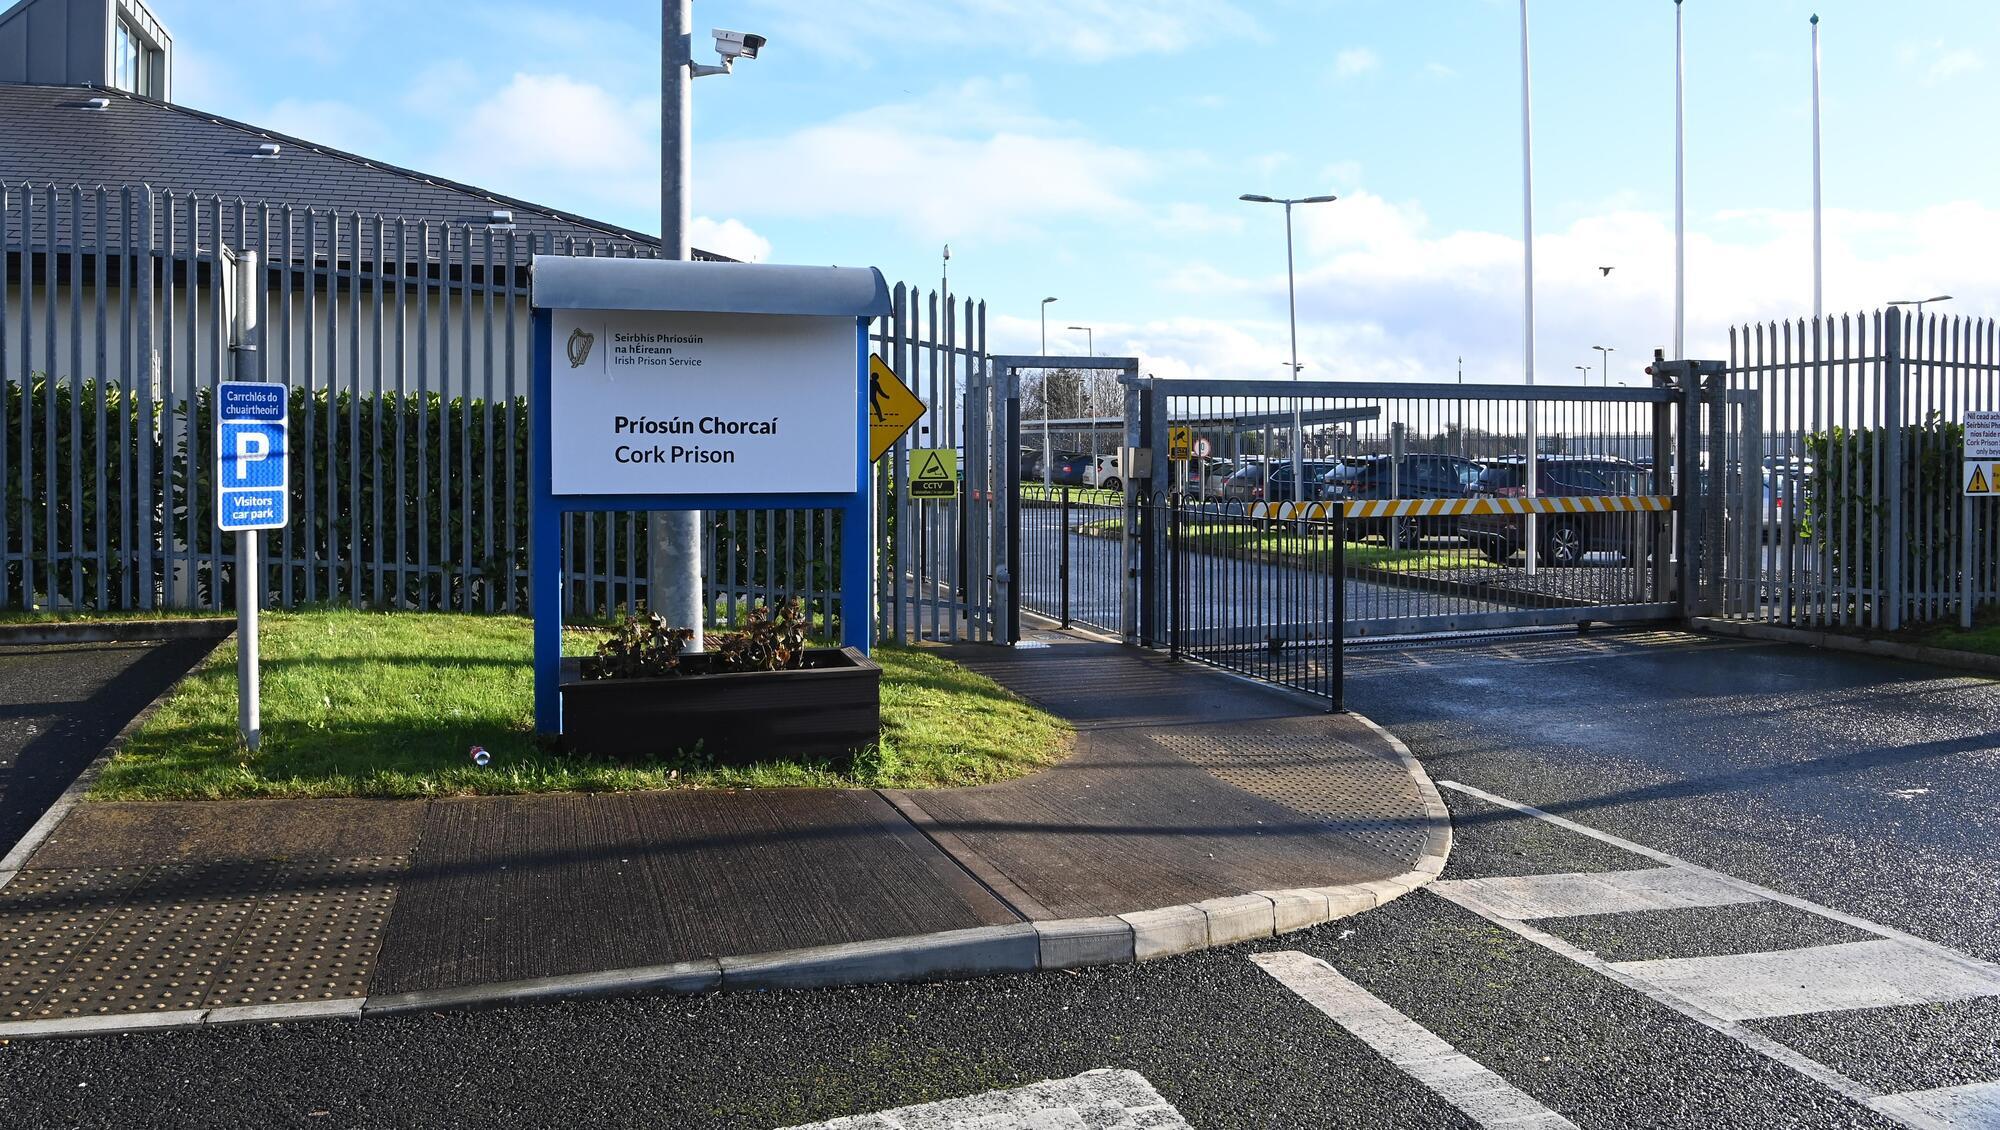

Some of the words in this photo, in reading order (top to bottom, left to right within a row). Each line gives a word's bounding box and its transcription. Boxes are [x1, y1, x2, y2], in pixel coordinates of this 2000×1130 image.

[615, 333, 655, 343] Seirbhís
[615, 346, 627, 354] na
[629, 342, 672, 354] hÉireann
[615, 356, 635, 365] Irish
[638, 356, 667, 366] Prison
[669, 357, 702, 366] Service
[227, 391, 266, 402] Carrchlós
[267, 392, 278, 402] do
[226, 404, 279, 415] chuairtheoirí
[614, 416, 694, 434] Príosún
[699, 416, 778, 435] Chorcaí
[1980, 439, 1998, 447] Prison
[236, 432, 270, 480] P
[615, 445, 666, 464] Cork
[671, 445, 735, 464] Prison
[1976, 448, 1988, 456] only
[234, 496, 273, 507] Visitors
[232, 511, 249, 520] car
[250, 508, 274, 520] park
